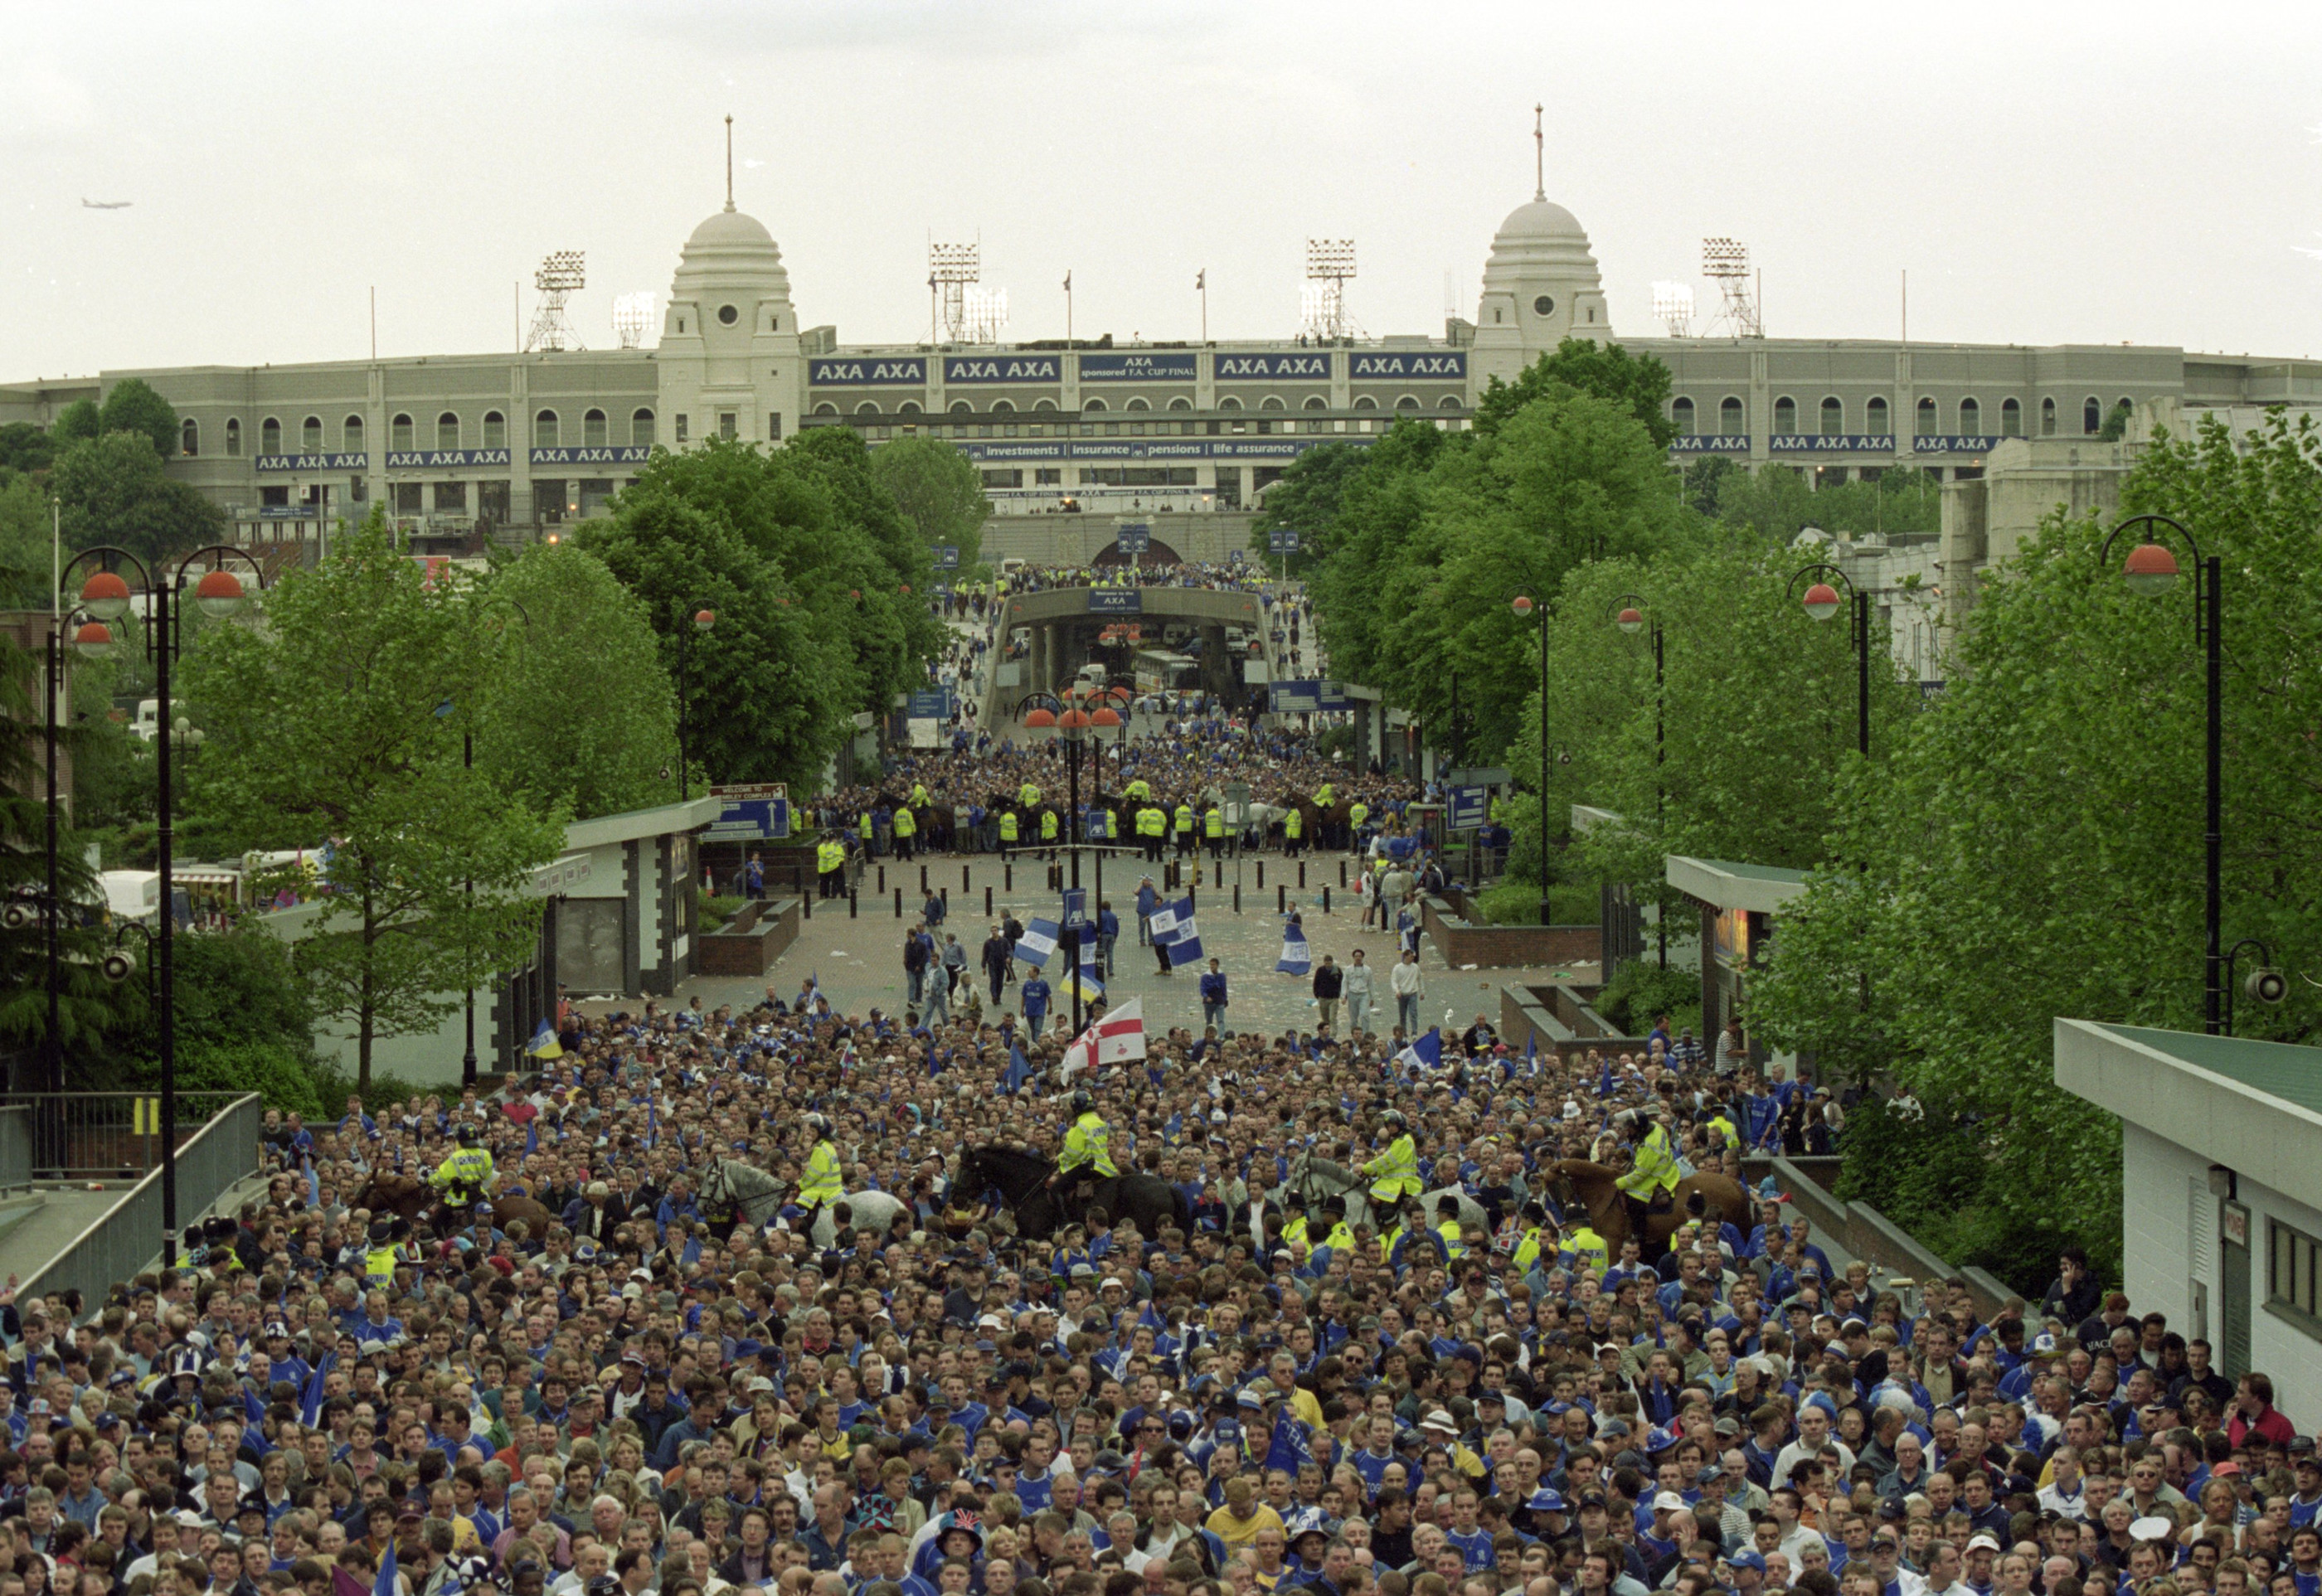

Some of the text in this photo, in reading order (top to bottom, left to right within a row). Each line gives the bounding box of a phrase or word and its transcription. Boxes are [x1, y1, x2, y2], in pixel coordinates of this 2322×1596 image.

[1125, 357, 1153, 366] AXA
[1221, 358, 1325, 374] AXA AXA
[1356, 358, 1460, 373] AXA AXA
[816, 363, 921, 380] AXA AXA
[950, 361, 1056, 377] AXA AXA
[1081, 369, 1125, 378] sponsored
[987, 445, 1059, 456] investments
[1072, 444, 1130, 455] insurance
[1149, 444, 1201, 456] pensions
[1213, 443, 1233, 454] life
[1236, 444, 1295, 454] assurance
[1710, 437, 1748, 449] AXA
[1772, 437, 1893, 449] AXA AXA AXA
[1916, 437, 1948, 449] AXA
[1955, 437, 1988, 449] AXA
[259, 455, 366, 469] AXA AXA AXA
[389, 451, 508, 465] AXA AXA AXA
[532, 449, 569, 462] AXA
[577, 449, 614, 461] AXA
[457, 1155, 481, 1165] POLICE
